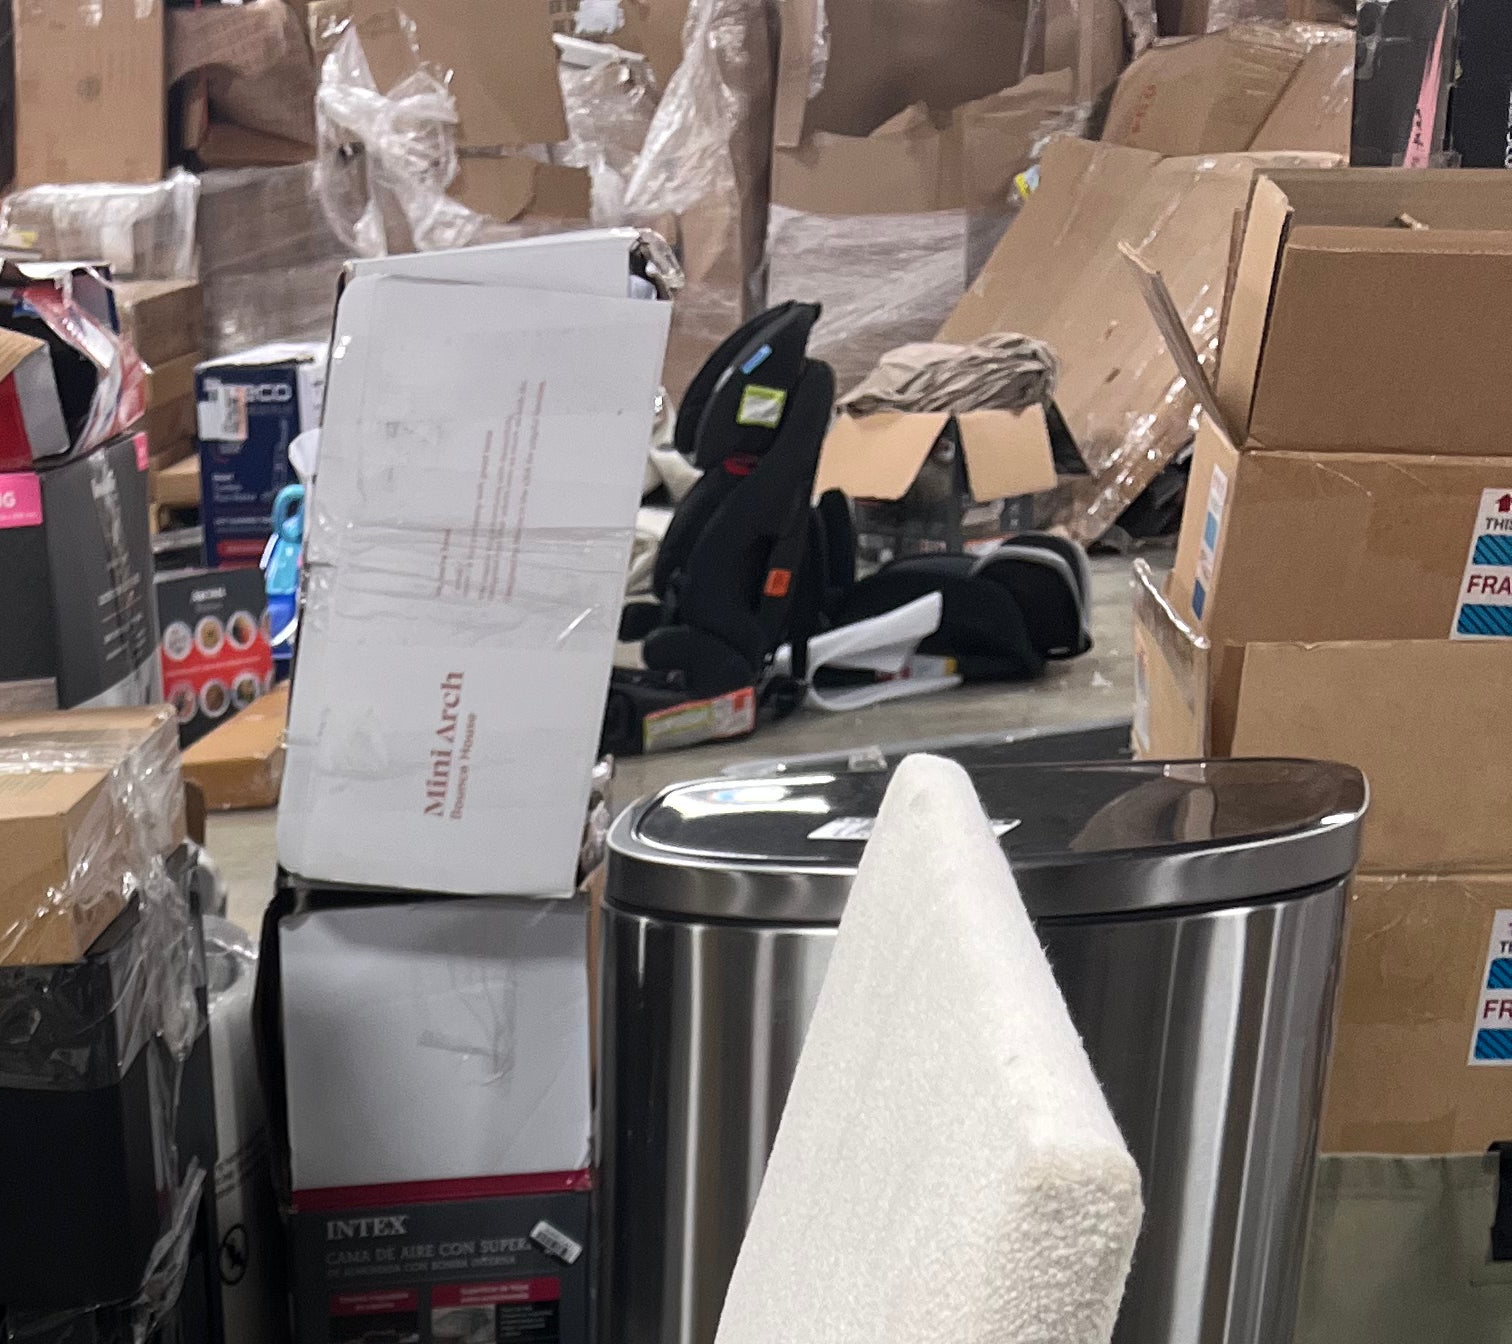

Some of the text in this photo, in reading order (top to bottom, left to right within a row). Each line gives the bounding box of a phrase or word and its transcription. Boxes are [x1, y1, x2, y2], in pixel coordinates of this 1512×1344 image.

[423, 672, 465, 817] Mini Arch
[326, 1215, 409, 1241] INTEX
[439, 1241, 475, 1257] CON
